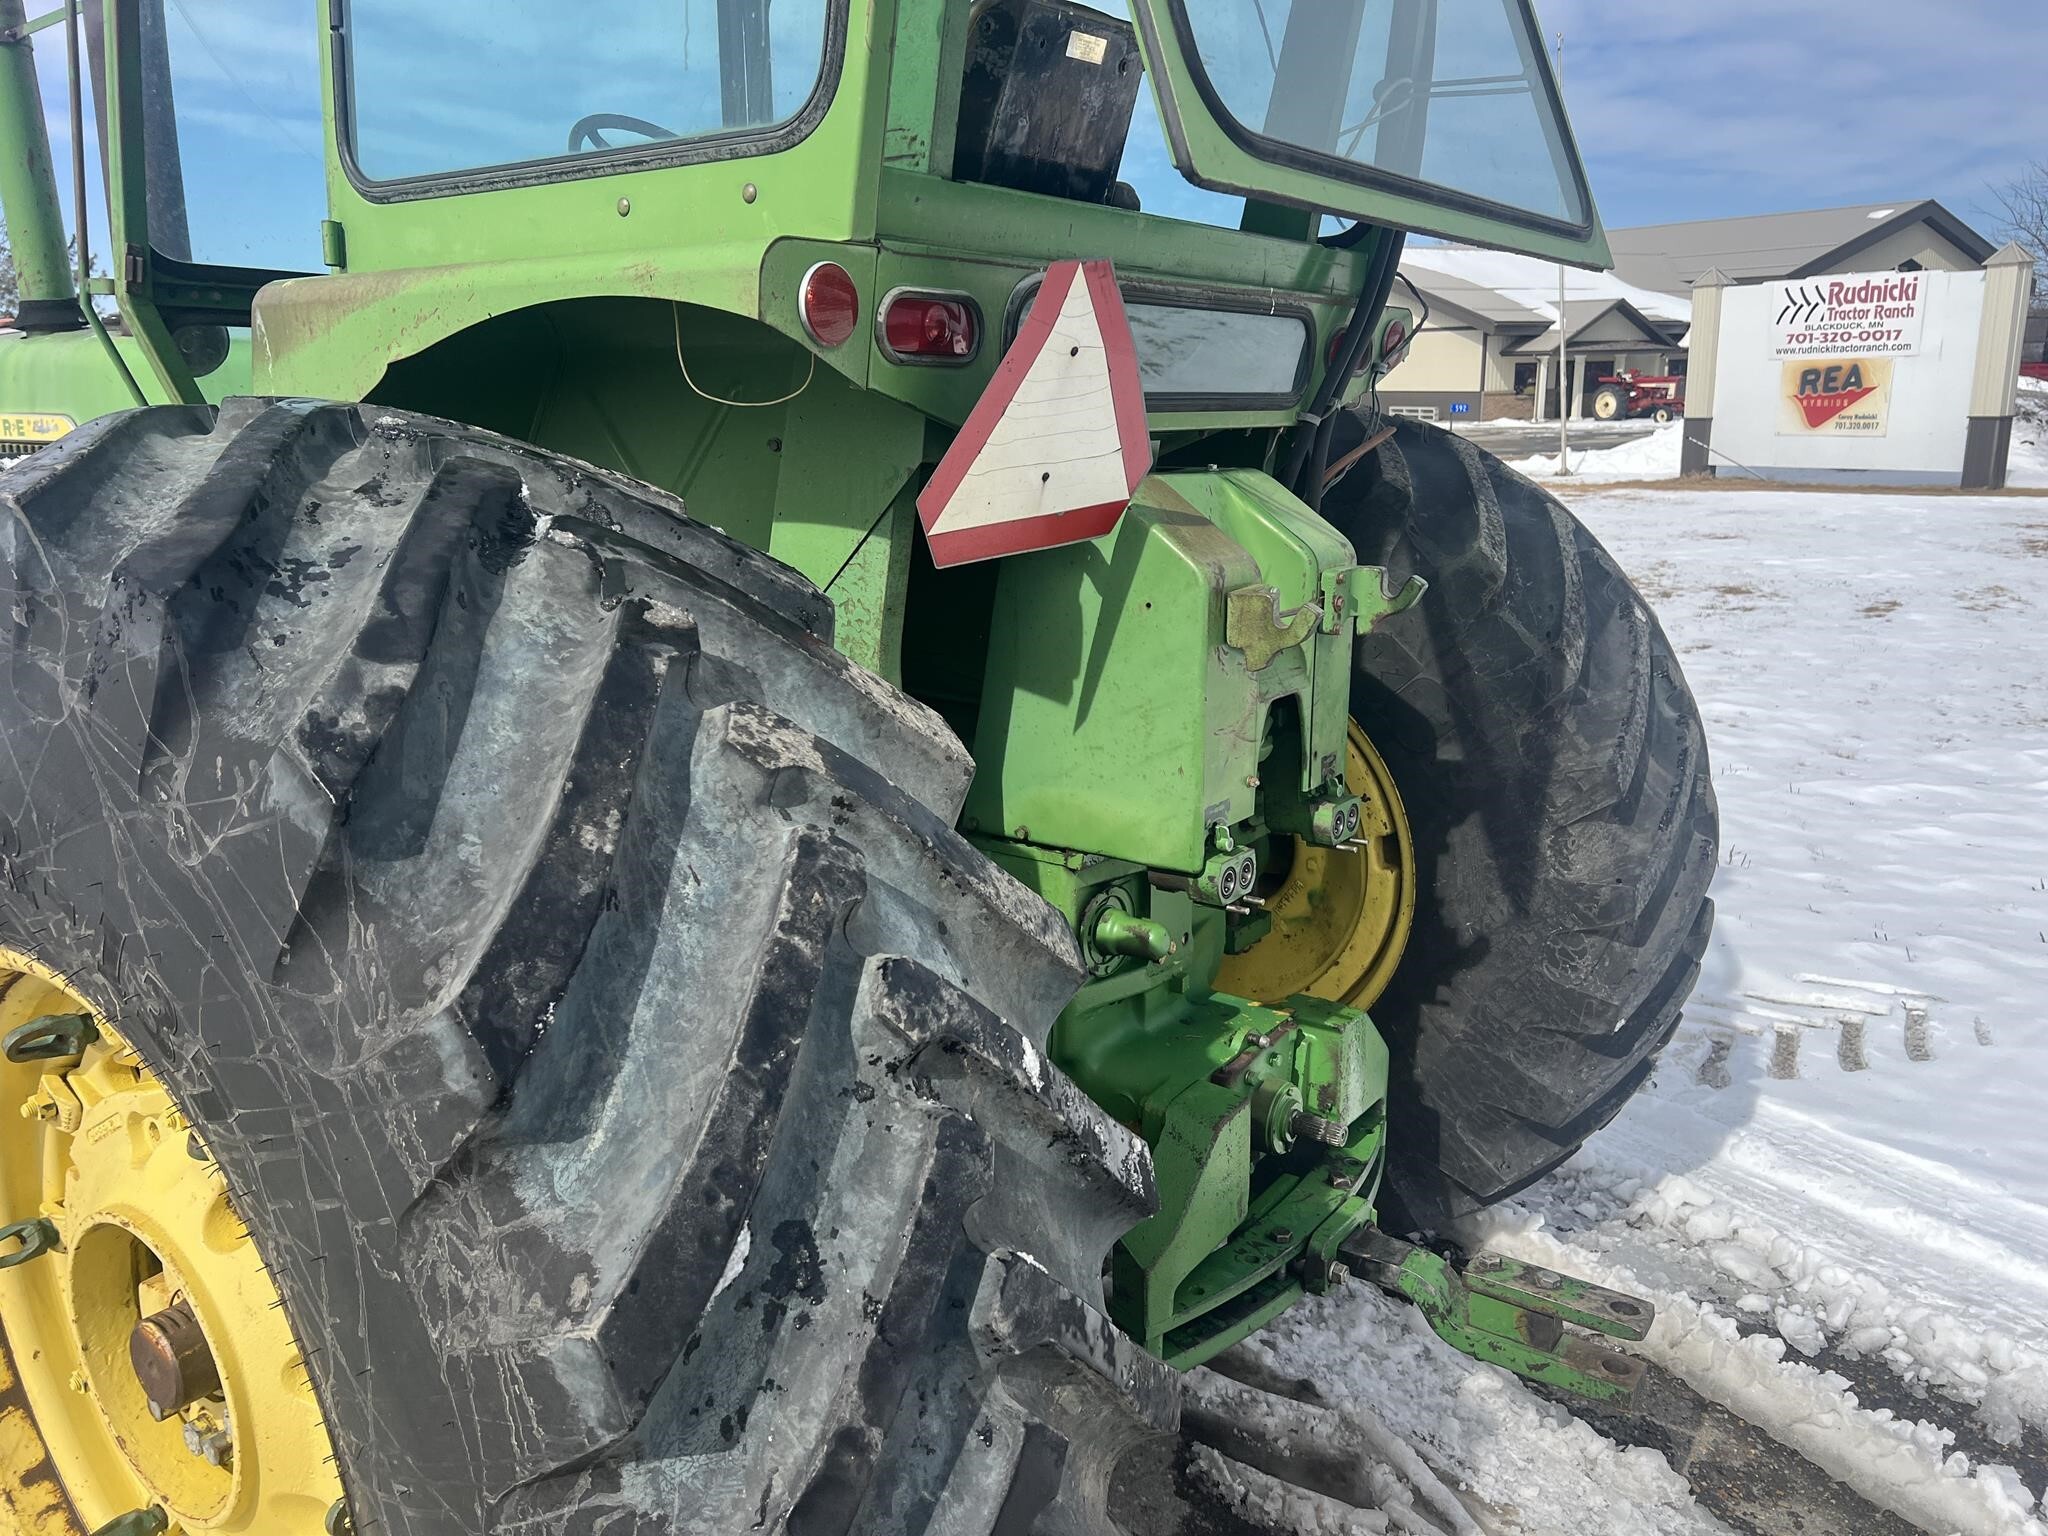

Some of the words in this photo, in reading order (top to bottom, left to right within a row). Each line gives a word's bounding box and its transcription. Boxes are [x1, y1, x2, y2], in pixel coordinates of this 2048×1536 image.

[1828, 277, 1918, 307] Rudnicki
[1827, 307, 1870, 321] Tractor
[1874, 303, 1915, 321] Ranch
[1805, 322, 1866, 332] BLACKDUCK,
[1868, 321, 1884, 329] MN
[1786, 329, 1903, 345] 701-320-0017
[1775, 342, 1912, 355] www.rudnickitractorranch.com
[1799, 363, 1864, 396] REA
[1834, 421, 1880, 430] 701.320.0017
